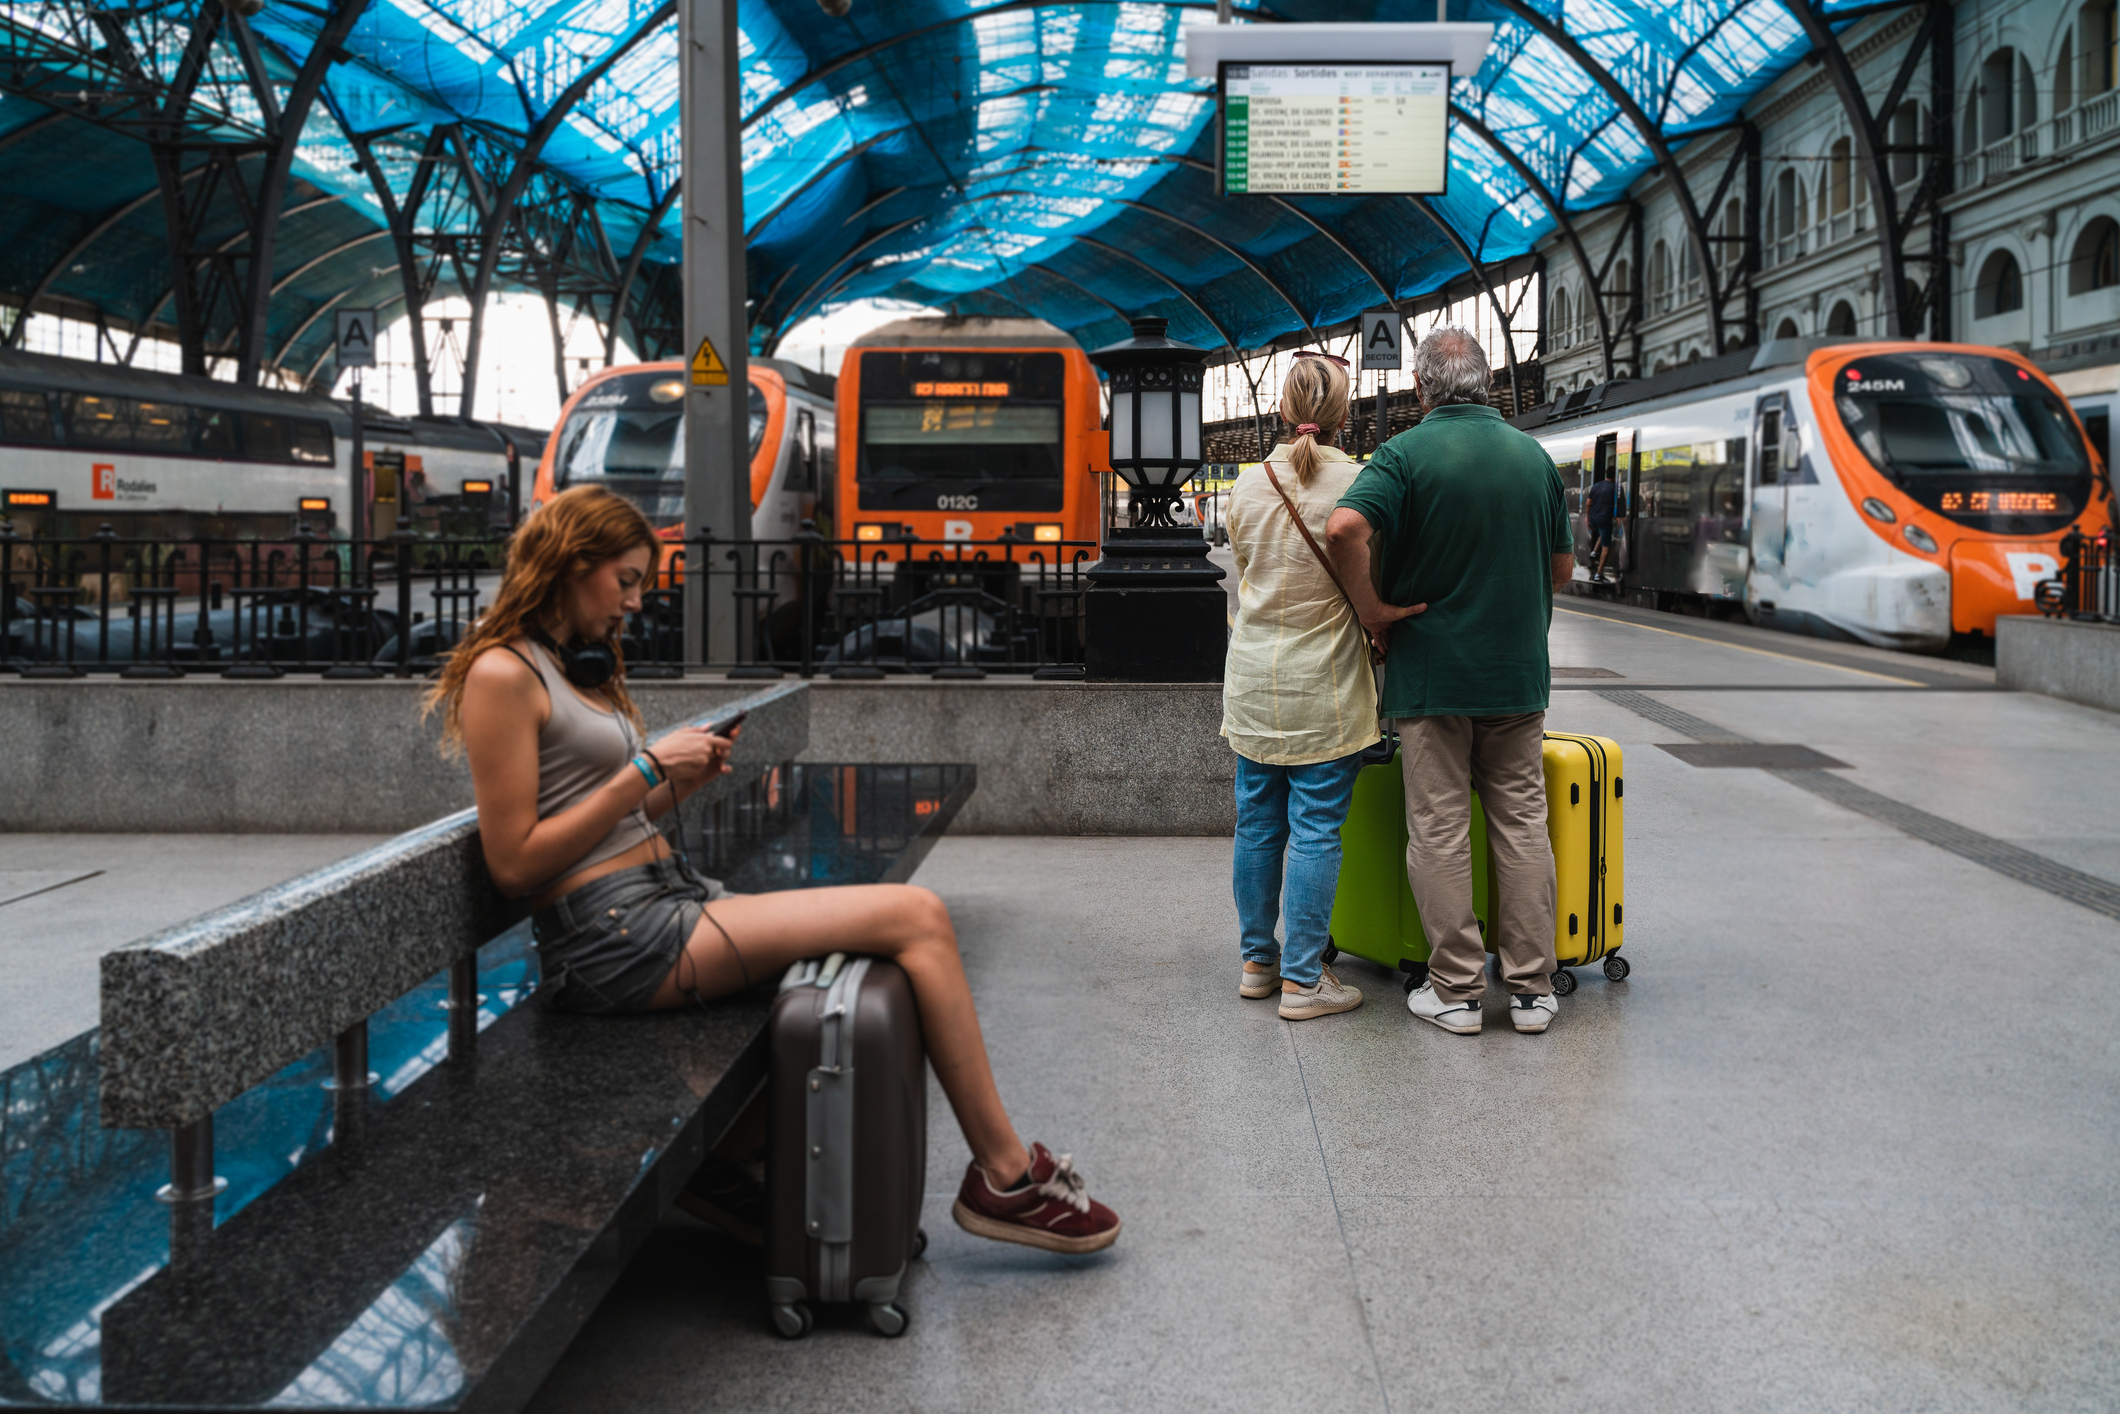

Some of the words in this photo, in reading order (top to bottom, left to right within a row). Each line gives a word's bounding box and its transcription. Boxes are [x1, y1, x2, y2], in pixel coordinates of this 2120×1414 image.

[1251, 68, 1288, 79] Salidas
[1294, 67, 1337, 79] Sortides
[1291, 182, 1300, 190] LA
[342, 317, 369, 348] A
[1368, 319, 1395, 349] A
[1365, 353, 1399, 361] SECTOR
[1847, 379, 1905, 394] 245M
[1212, 465, 1220, 475] B
[1227, 466, 1235, 477] 4
[100, 469, 115, 493] R
[117, 478, 157, 494] Rodalies
[937, 495, 979, 510] 012C
[944, 520, 974, 551] R
